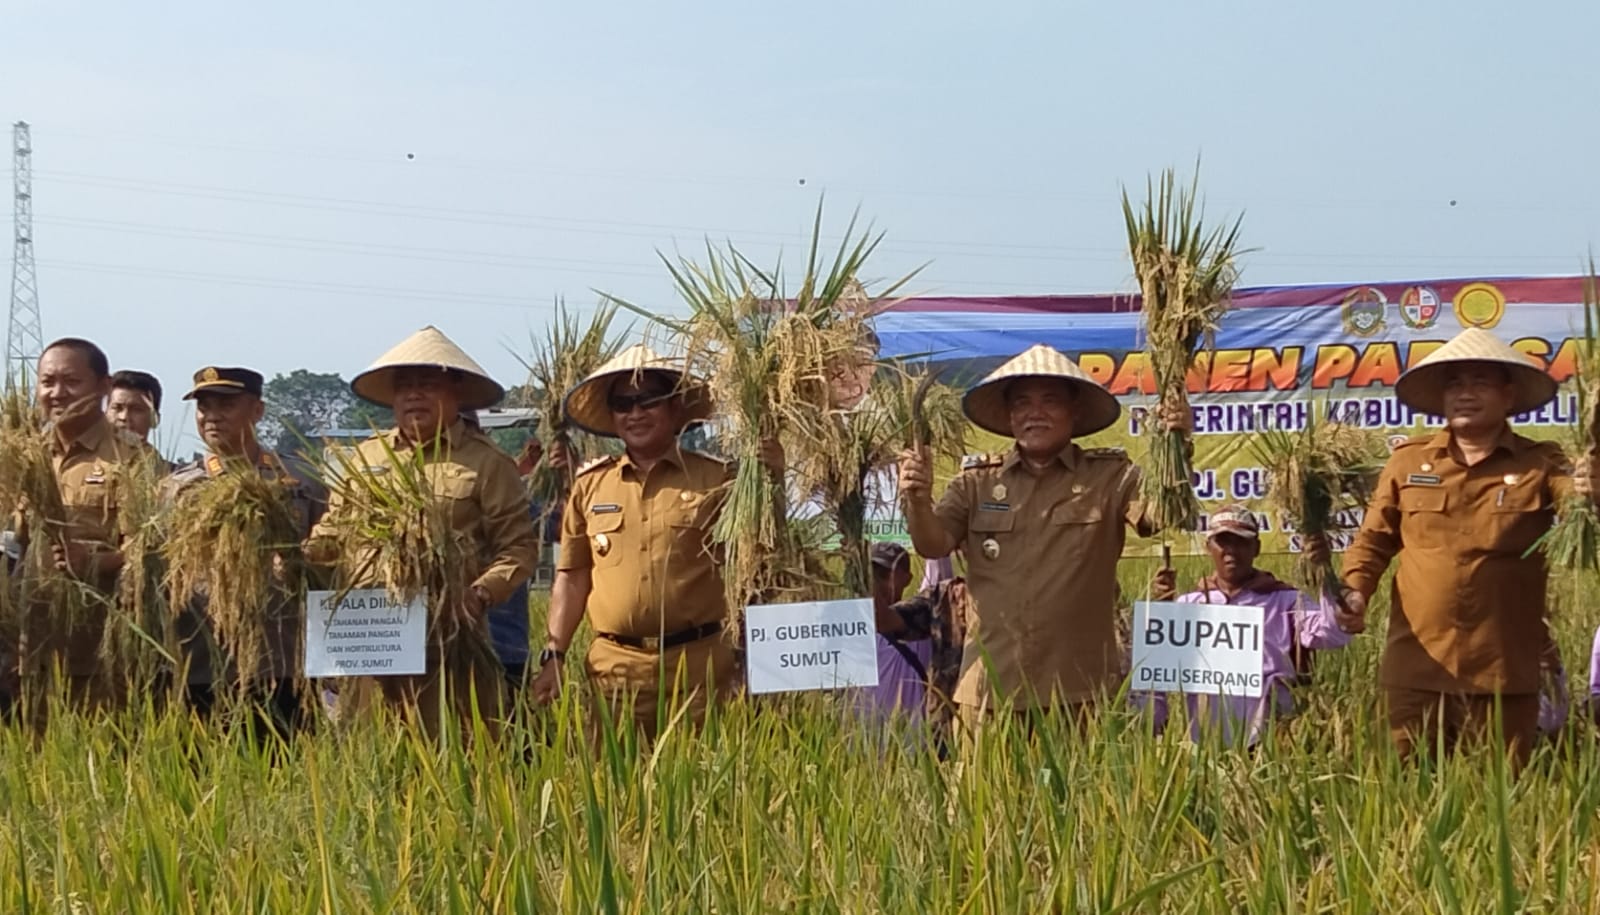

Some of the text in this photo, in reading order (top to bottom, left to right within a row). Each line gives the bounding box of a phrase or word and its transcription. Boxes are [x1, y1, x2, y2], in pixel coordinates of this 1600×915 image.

[320, 597, 366, 611] KEALA
[370, 616, 402, 625] PANGAN
[328, 629, 401, 640] TANAMAN PANGAN
[751, 621, 868, 642] PJ. GUBERNUR
[1145, 618, 1259, 651] BUPATI
[327, 643, 402, 654] DAN HORTIKULTURA
[361, 658, 394, 668] SUMUT
[780, 650, 841, 668] SUMUT
[1140, 667, 1260, 688] DELI SERDANG
